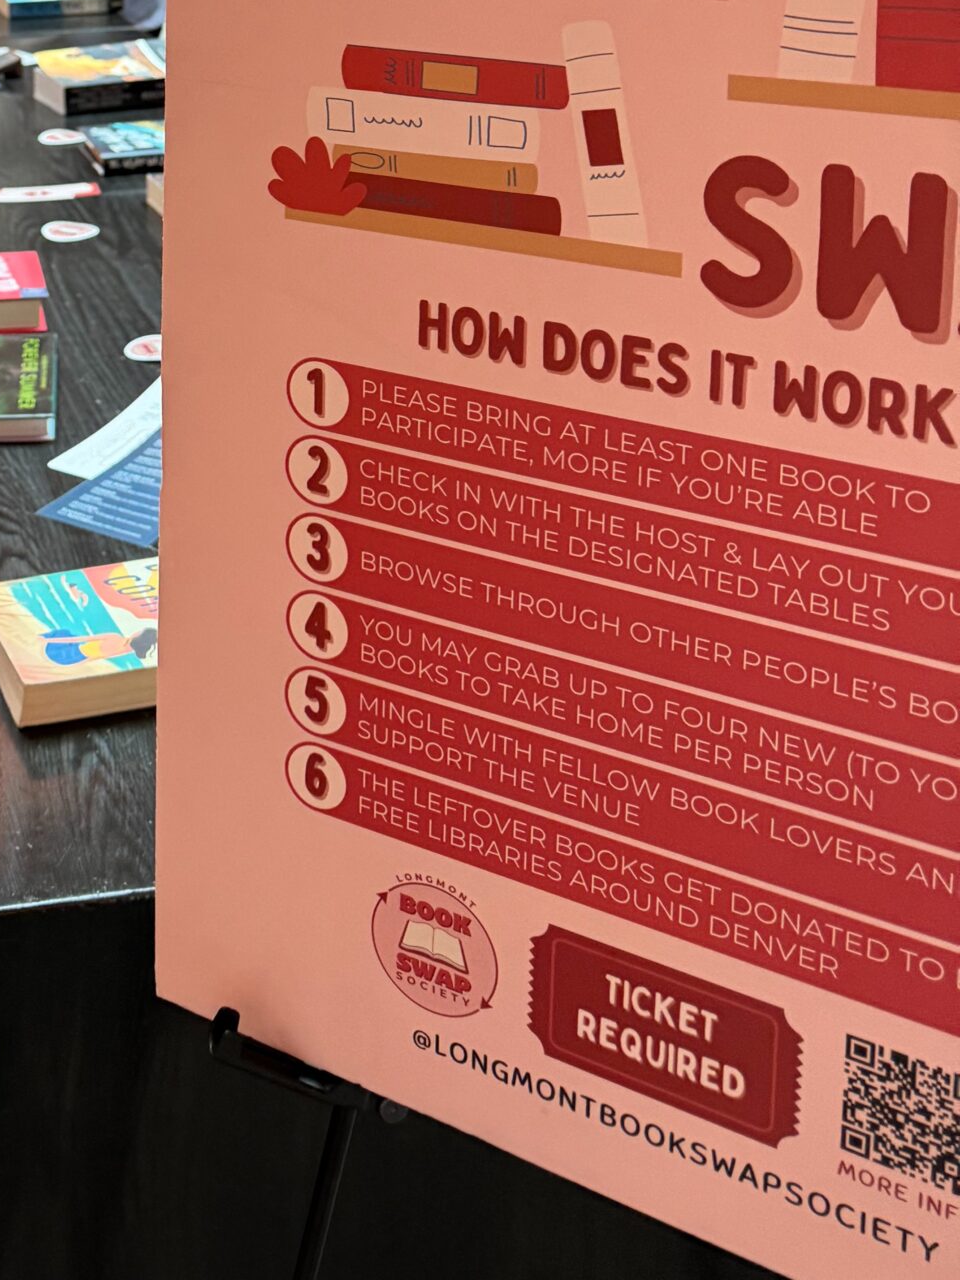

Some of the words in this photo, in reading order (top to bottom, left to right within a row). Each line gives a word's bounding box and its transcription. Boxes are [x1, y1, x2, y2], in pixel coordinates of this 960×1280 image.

[700, 155, 960, 344] SW
[307, 368, 325, 418] 1
[418, 299, 526, 368] HOW
[542, 320, 691, 397] DOES
[709, 349, 757, 409] IT
[773, 360, 958, 449] WORK
[307, 445, 331, 497] 2
[362, 408, 533, 466] PARTICIPATE,
[544, 446, 627, 482] MORE
[638, 466, 662, 488] IF
[670, 473, 783, 516] YOU’RE
[793, 500, 878, 536] ABLE
[363, 380, 456, 417] PLEASE
[467, 401, 550, 436] BRING
[560, 422, 595, 444] AT
[605, 429, 692, 464] LEAST
[701, 450, 767, 482] ONE
[780, 464, 875, 504] BOOK
[885, 485, 930, 513] TO
[307, 523, 331, 575] 3
[360, 459, 447, 496] CHECK
[456, 480, 480, 504] IN
[490, 488, 560, 523] WITH
[570, 506, 624, 538] THE
[636, 522, 715, 557] HOST
[724, 542, 742, 565] &
[753, 548, 810, 579] LAY
[819, 564, 889, 598] OUT
[361, 486, 449, 524] BOOKS
[458, 511, 496, 536] ON
[506, 521, 558, 552] THE
[569, 536, 758, 598] DESIGNATED
[768, 582, 890, 631] TABLES
[305, 597, 334, 652] 4
[362, 551, 473, 598] BROWSE
[480, 582, 620, 636] THROUGH
[630, 622, 732, 666] OTHER
[743, 649, 896, 709] PEOPLE’S
[305, 675, 330, 726] 5
[360, 616, 411, 646] YOU
[422, 633, 477, 664] MAY
[484, 652, 559, 688] GRAB
[570, 674, 607, 699] UP
[616, 686, 653, 714] TO
[664, 700, 748, 742] FOUR
[760, 727, 836, 766] NEW
[848, 751, 900, 784] (TO
[361, 643, 448, 685] BOOKS
[456, 670, 490, 696] TO
[498, 682, 566, 720] TAKE
[577, 705, 663, 748] HOME
[674, 733, 732, 768] PER
[744, 753, 873, 810] PERSON
[305, 752, 330, 810] 6
[358, 720, 478, 772] SUPPORT
[483, 758, 535, 792] THE
[544, 777, 640, 826] VENUE
[360, 693, 454, 739] MINGLE
[464, 724, 531, 763] WITH
[543, 748, 660, 800] FELLOW
[671, 787, 759, 834] BOOK
[770, 818, 896, 875] LOVERS
[358, 769, 404, 801] THE
[414, 787, 546, 848] LEFTOVER
[556, 834, 654, 884] BOOKS
[664, 872, 721, 905] GET
[732, 892, 889, 962] DONATED
[900, 949, 944, 981] TO
[360, 796, 419, 833] FREE
[429, 820, 561, 881] LIBRARIES
[570, 870, 698, 927] AROUND
[710, 915, 838, 978] DENVER
[396, 873, 476, 908] LONGMONT
[400, 892, 472, 937] BOOK
[396, 952, 472, 994] SWAP
[396, 971, 470, 1006] SOCIETY
[605, 973, 719, 1043] TICKET
[577, 1008, 746, 1100] REQUIRED
[413, 1030, 939, 1262] @LONGMONTBOOKSWAPSOCIETY
[837, 1160, 908, 1203] MORE
